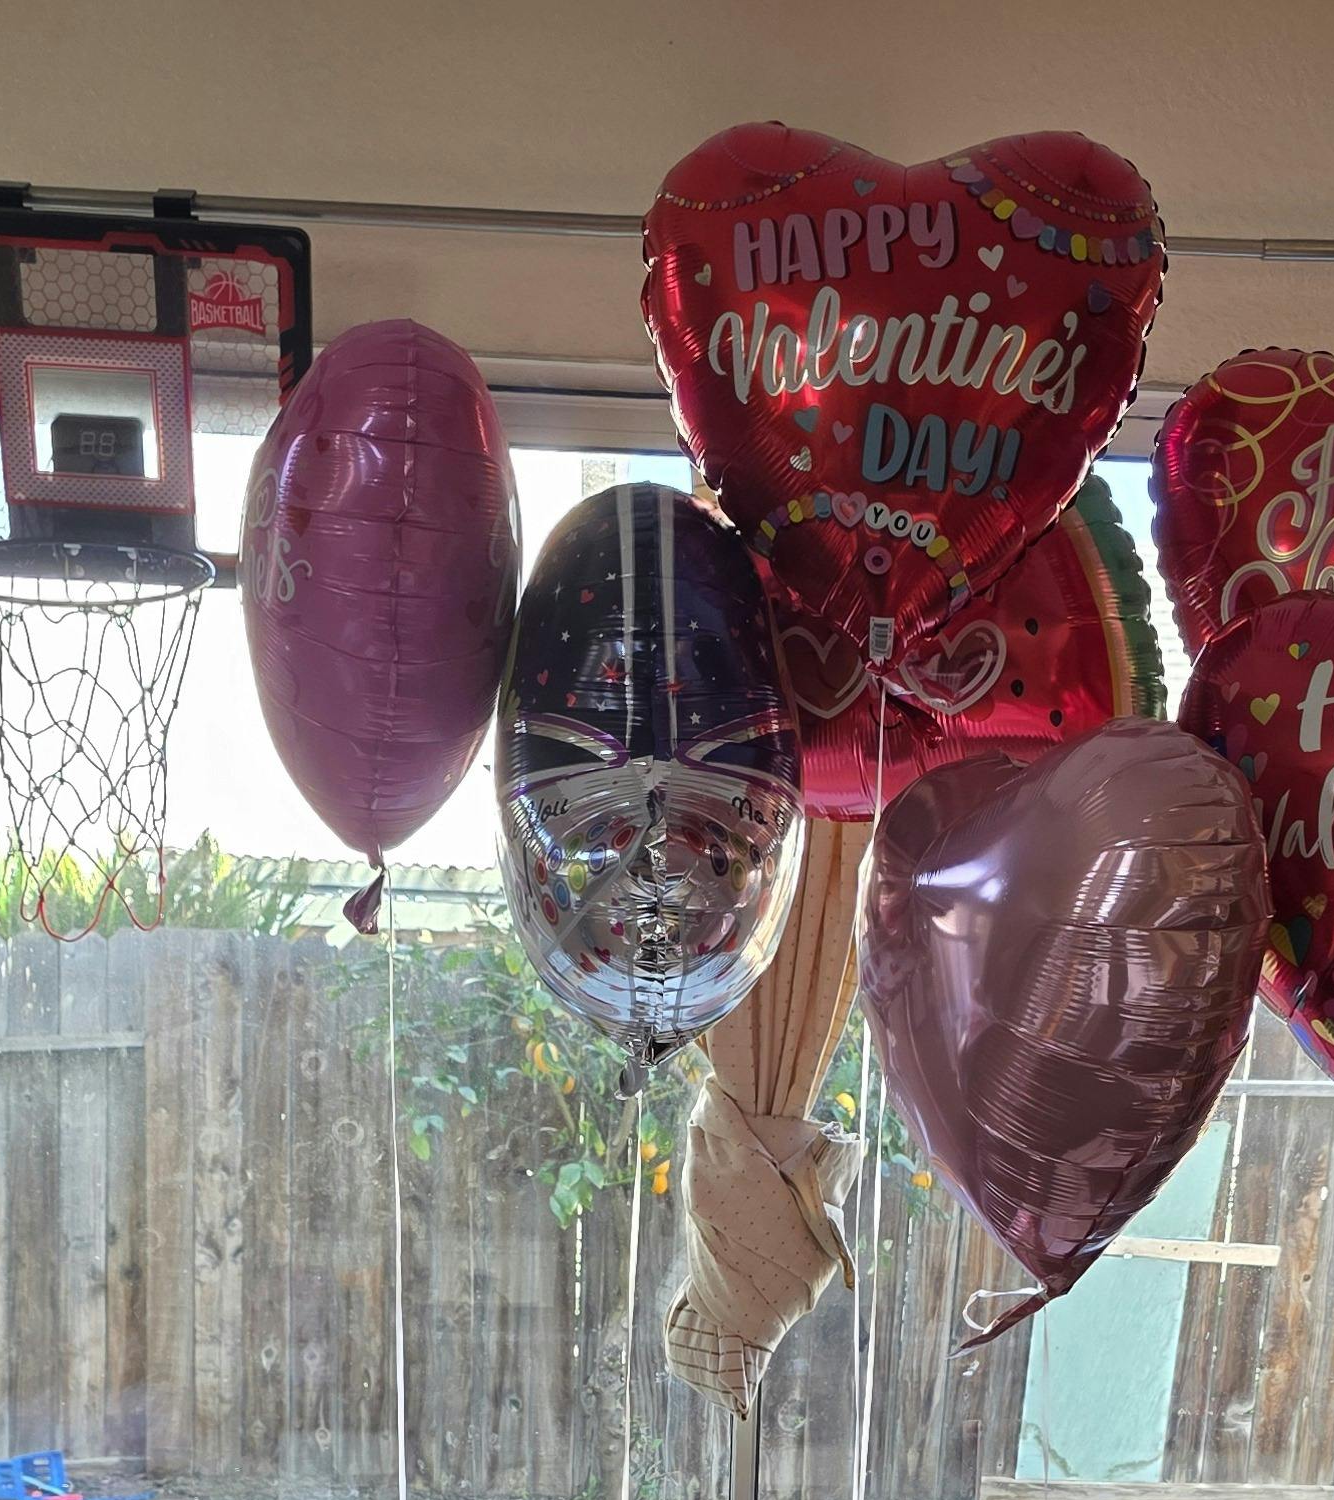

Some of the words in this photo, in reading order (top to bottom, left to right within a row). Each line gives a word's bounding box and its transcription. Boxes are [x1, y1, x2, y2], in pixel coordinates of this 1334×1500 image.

[734, 200, 956, 293] HAPPY
[190, 299, 263, 331] BASKETBALL
[708, 286, 1087, 414] Valentine's
[861, 403, 1021, 500] DAY!
[872, 507, 932, 541] YOU
